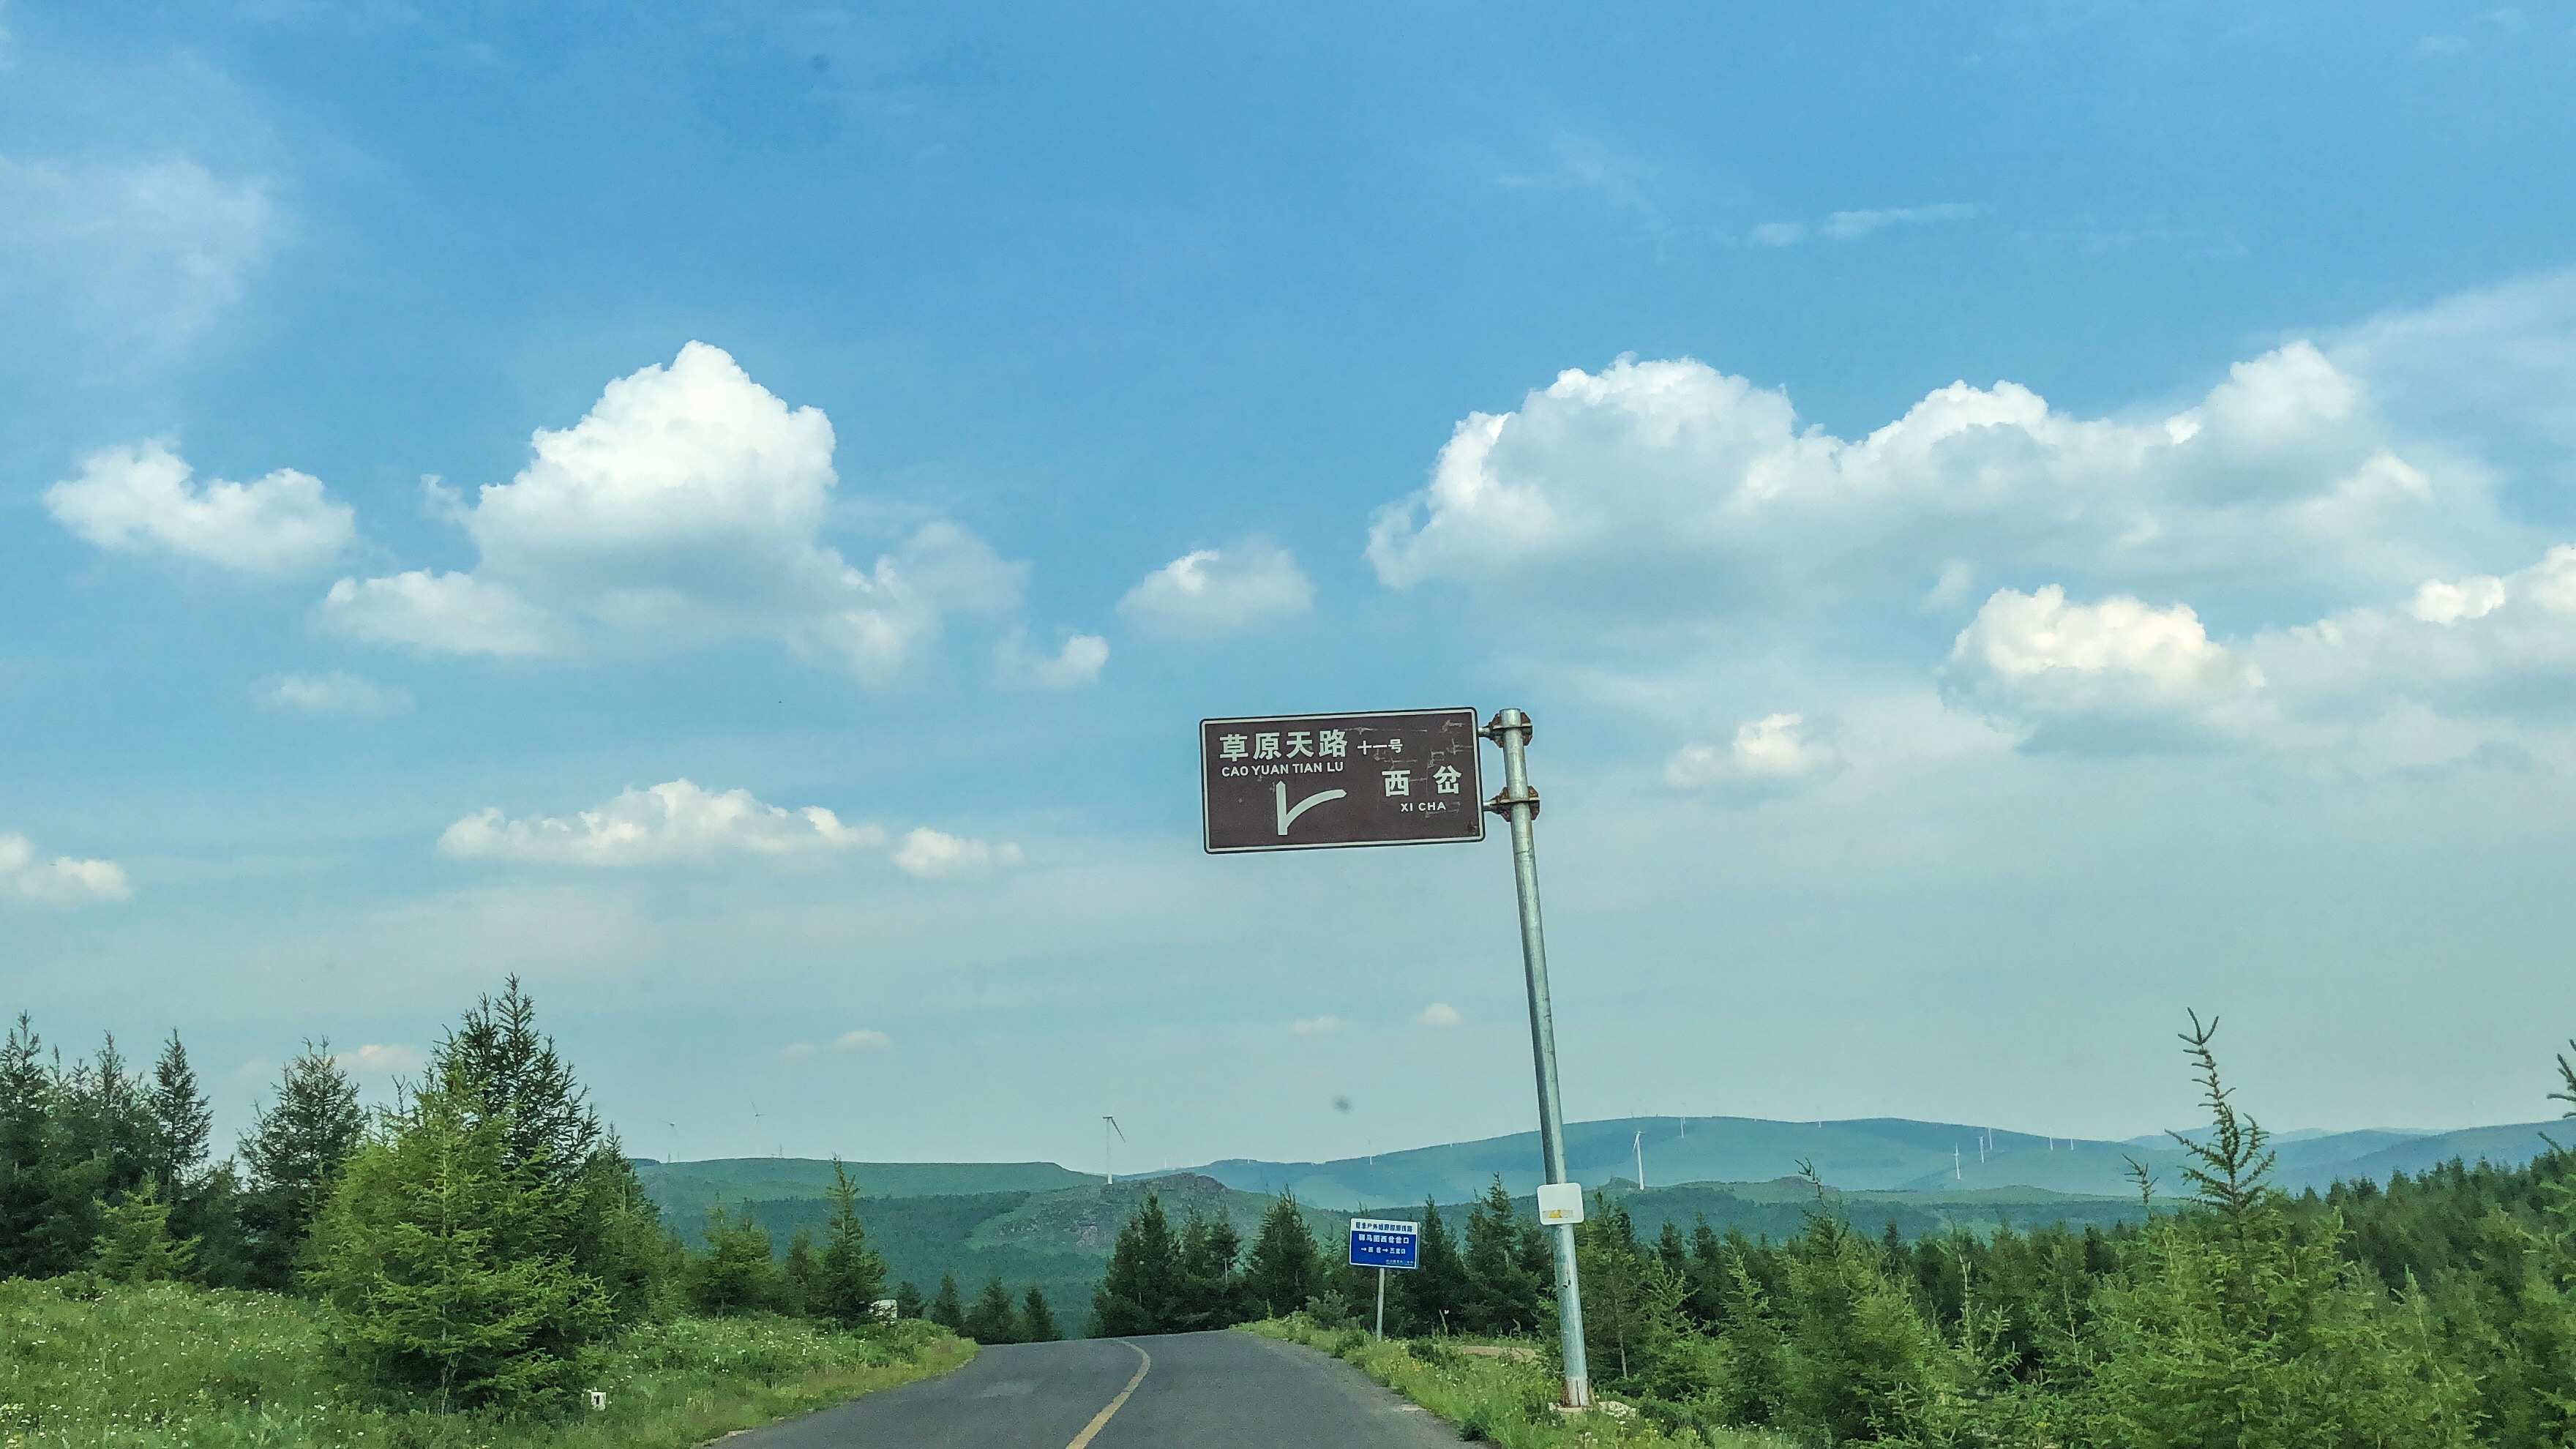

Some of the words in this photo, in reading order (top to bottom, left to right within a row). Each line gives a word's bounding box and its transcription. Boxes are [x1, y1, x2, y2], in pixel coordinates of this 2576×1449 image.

[1219, 730, 1348, 762] 草原天路
[1357, 738, 1403, 755] 十一号
[1221, 766, 1248, 776] CAO
[1251, 764, 1289, 775] YUAN
[1292, 763, 1322, 774] TIAN
[1328, 761, 1344, 772] LU
[1401, 803, 1413, 812] XI
[1418, 801, 1446, 811] CHA
